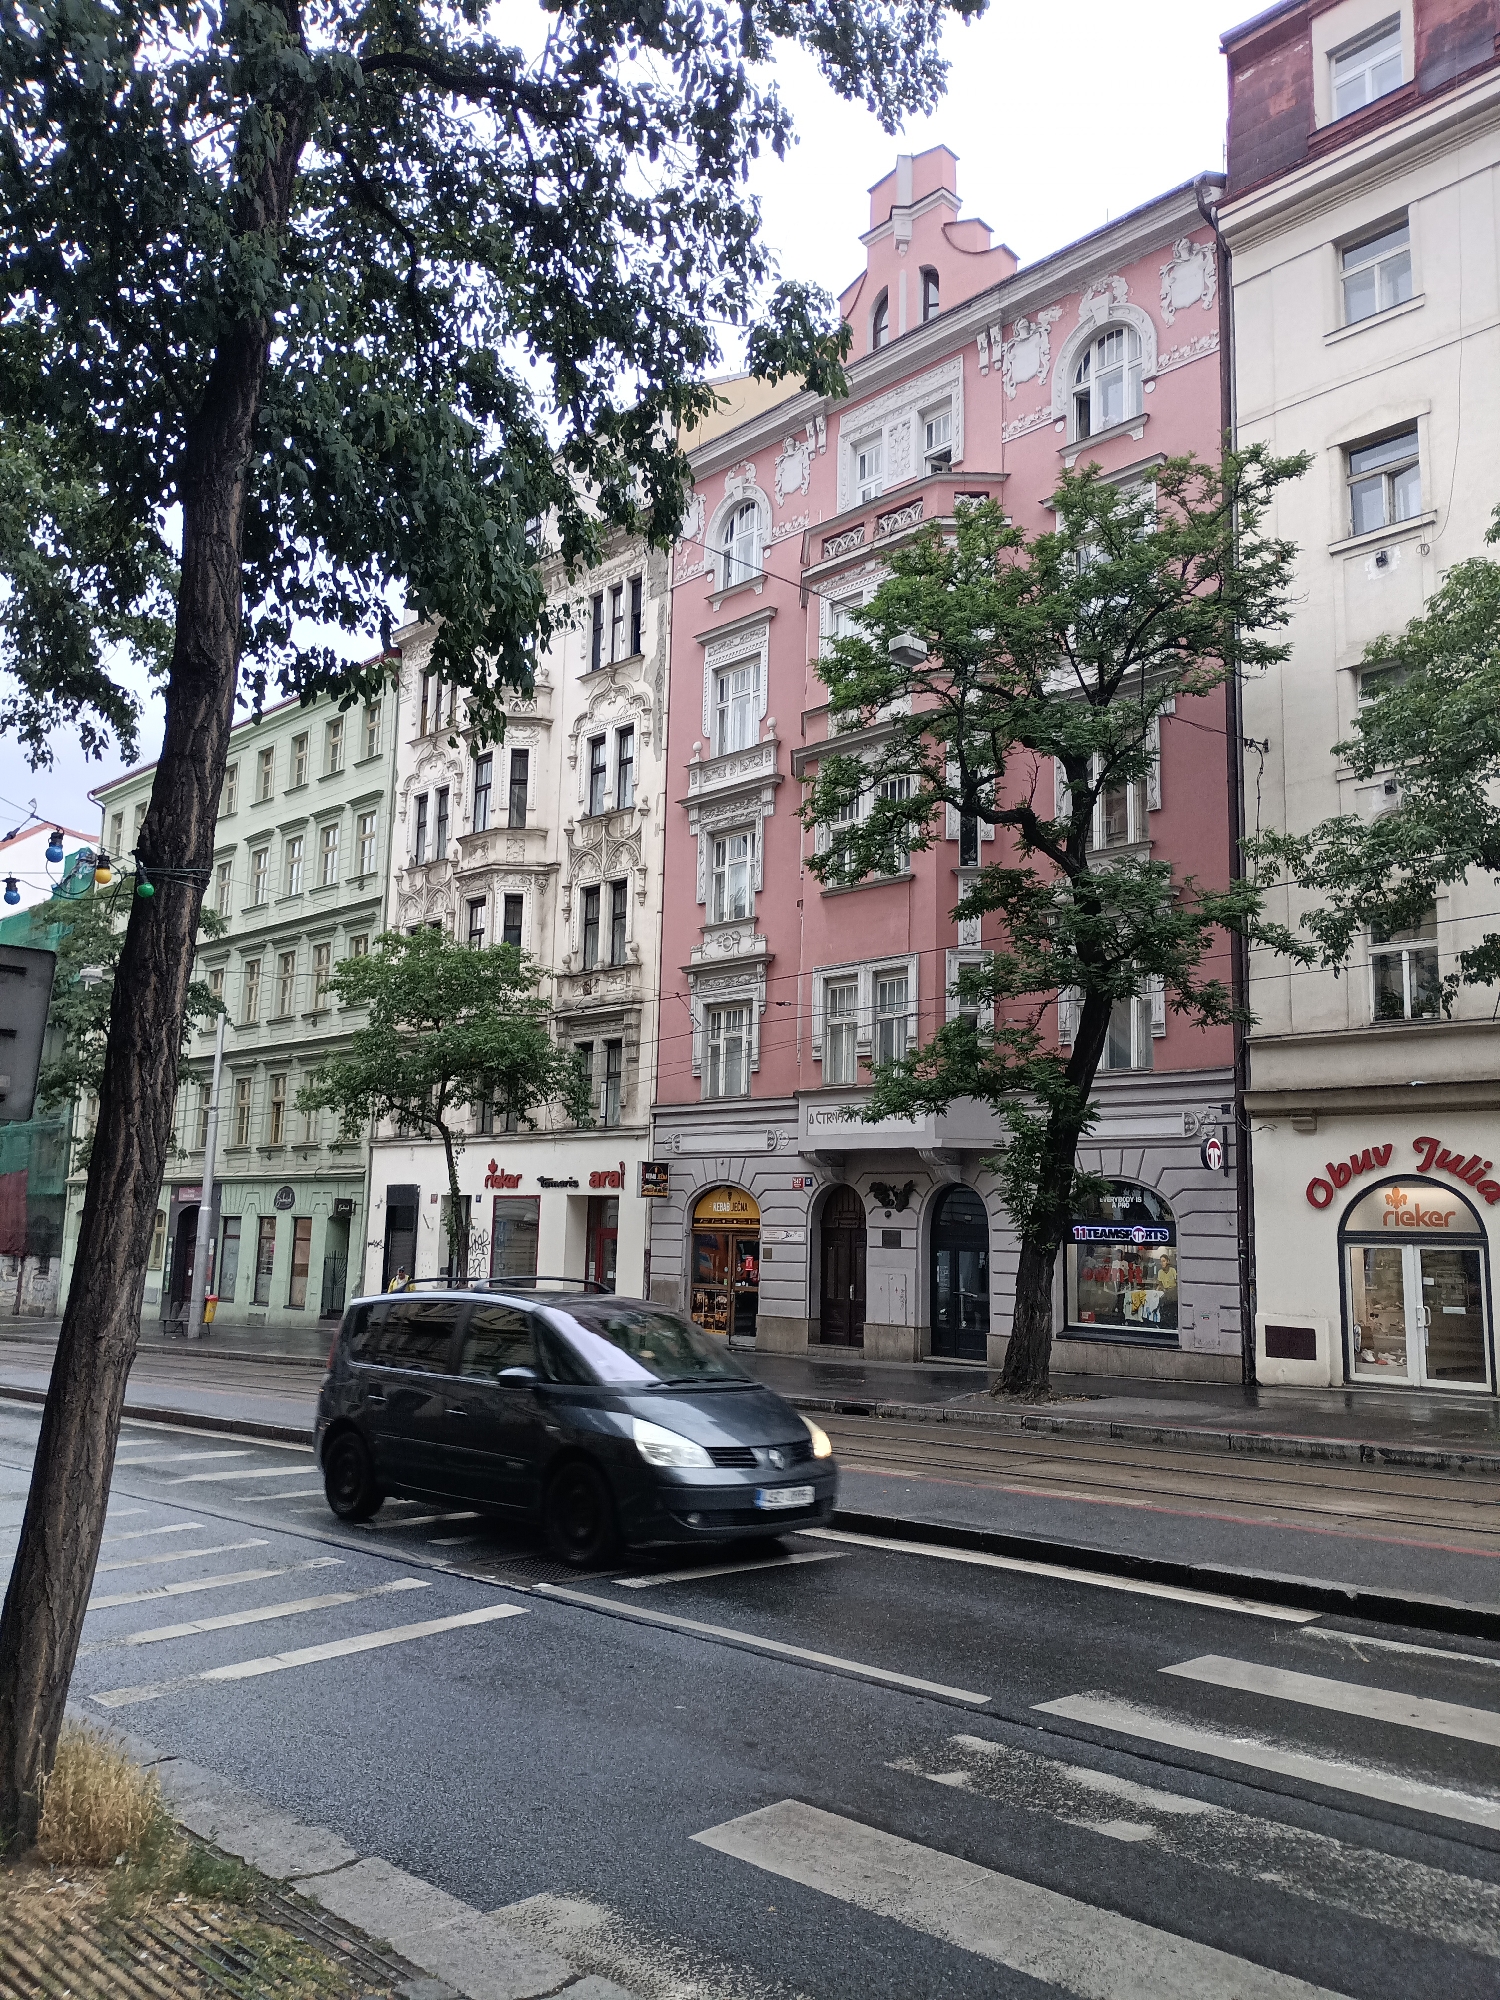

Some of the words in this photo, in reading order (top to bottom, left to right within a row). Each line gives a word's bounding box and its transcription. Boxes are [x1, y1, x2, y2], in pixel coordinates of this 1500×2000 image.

[484, 1166, 523, 1189] rieker
[1306, 1143, 1394, 1209] Obuv
[1412, 1136, 1500, 1206] Julia
[712, 1202, 731, 1212] KEBAB
[1383, 1203, 1456, 1228] rieker
